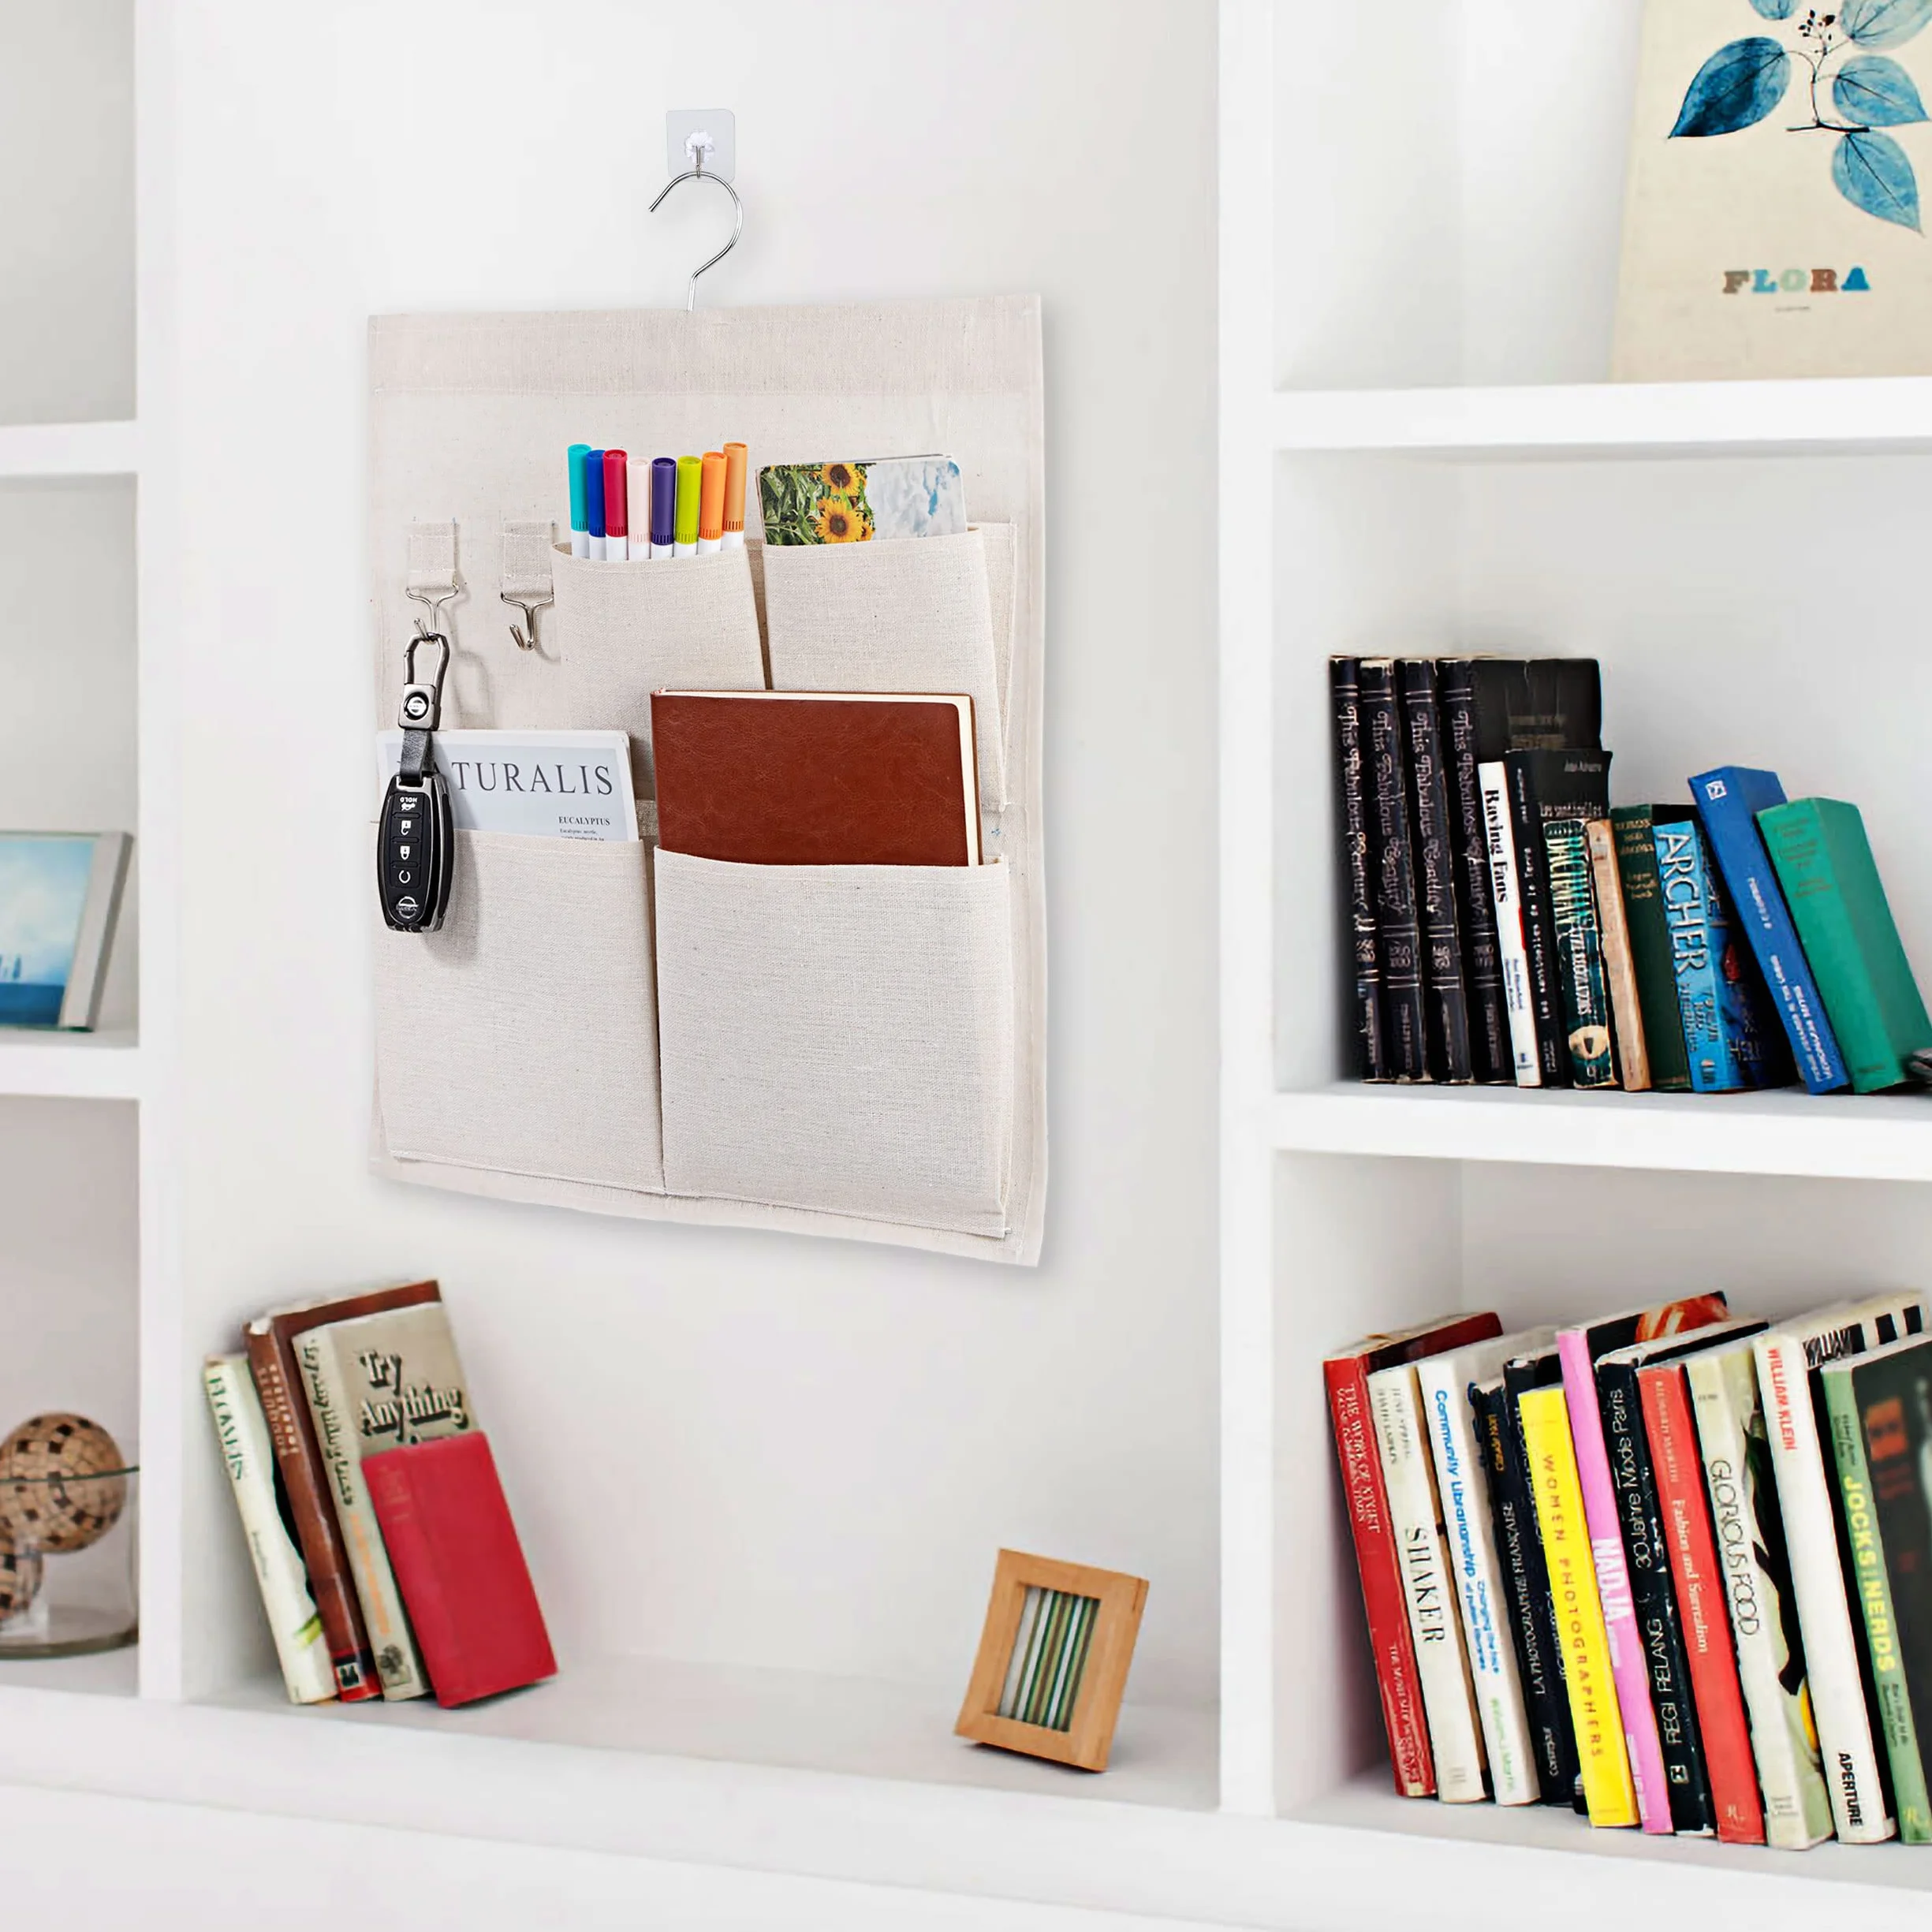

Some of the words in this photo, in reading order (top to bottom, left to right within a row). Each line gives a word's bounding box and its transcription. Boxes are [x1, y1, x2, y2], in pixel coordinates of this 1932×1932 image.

[1722, 266, 1870, 294] FLORA
[451, 761, 613, 795] TURALIS
[558, 816, 610, 826] EUCALYPTUS
[1484, 789, 1505, 856] Raving
[1493, 860, 1511, 904] Fans
[1657, 833, 1708, 975] ARCHER
[360, 1350, 402, 1395] Try
[1766, 1348, 1790, 1407] WILLIAM
[360, 1383, 468, 1442] Anything
[1607, 1387, 1629, 1433] Paris
[1776, 1408, 1797, 1452] KLEIN
[1434, 1389, 1460, 1476] Community
[1450, 1481, 1476, 1577] Librarianship
[1616, 1437, 1638, 1488] Mode
[1624, 1492, 1647, 1542] Jahre
[1841, 1472, 1879, 1568] JOCKS
[1681, 1552, 1699, 1580] and
[1710, 1459, 1748, 1568] GLORIOUS
[1729, 1571, 1761, 1637] FOOD
[1402, 1524, 1447, 1644] SHAKER
[1542, 1455, 1566, 1542] WOMEN
[1559, 1557, 1602, 1758] PHOTOGRAPHERS
[1859, 1578, 1899, 1673] NERDS
[1533, 1676, 1546, 1695] LA
[1837, 1751, 1863, 1828] APERTURE
